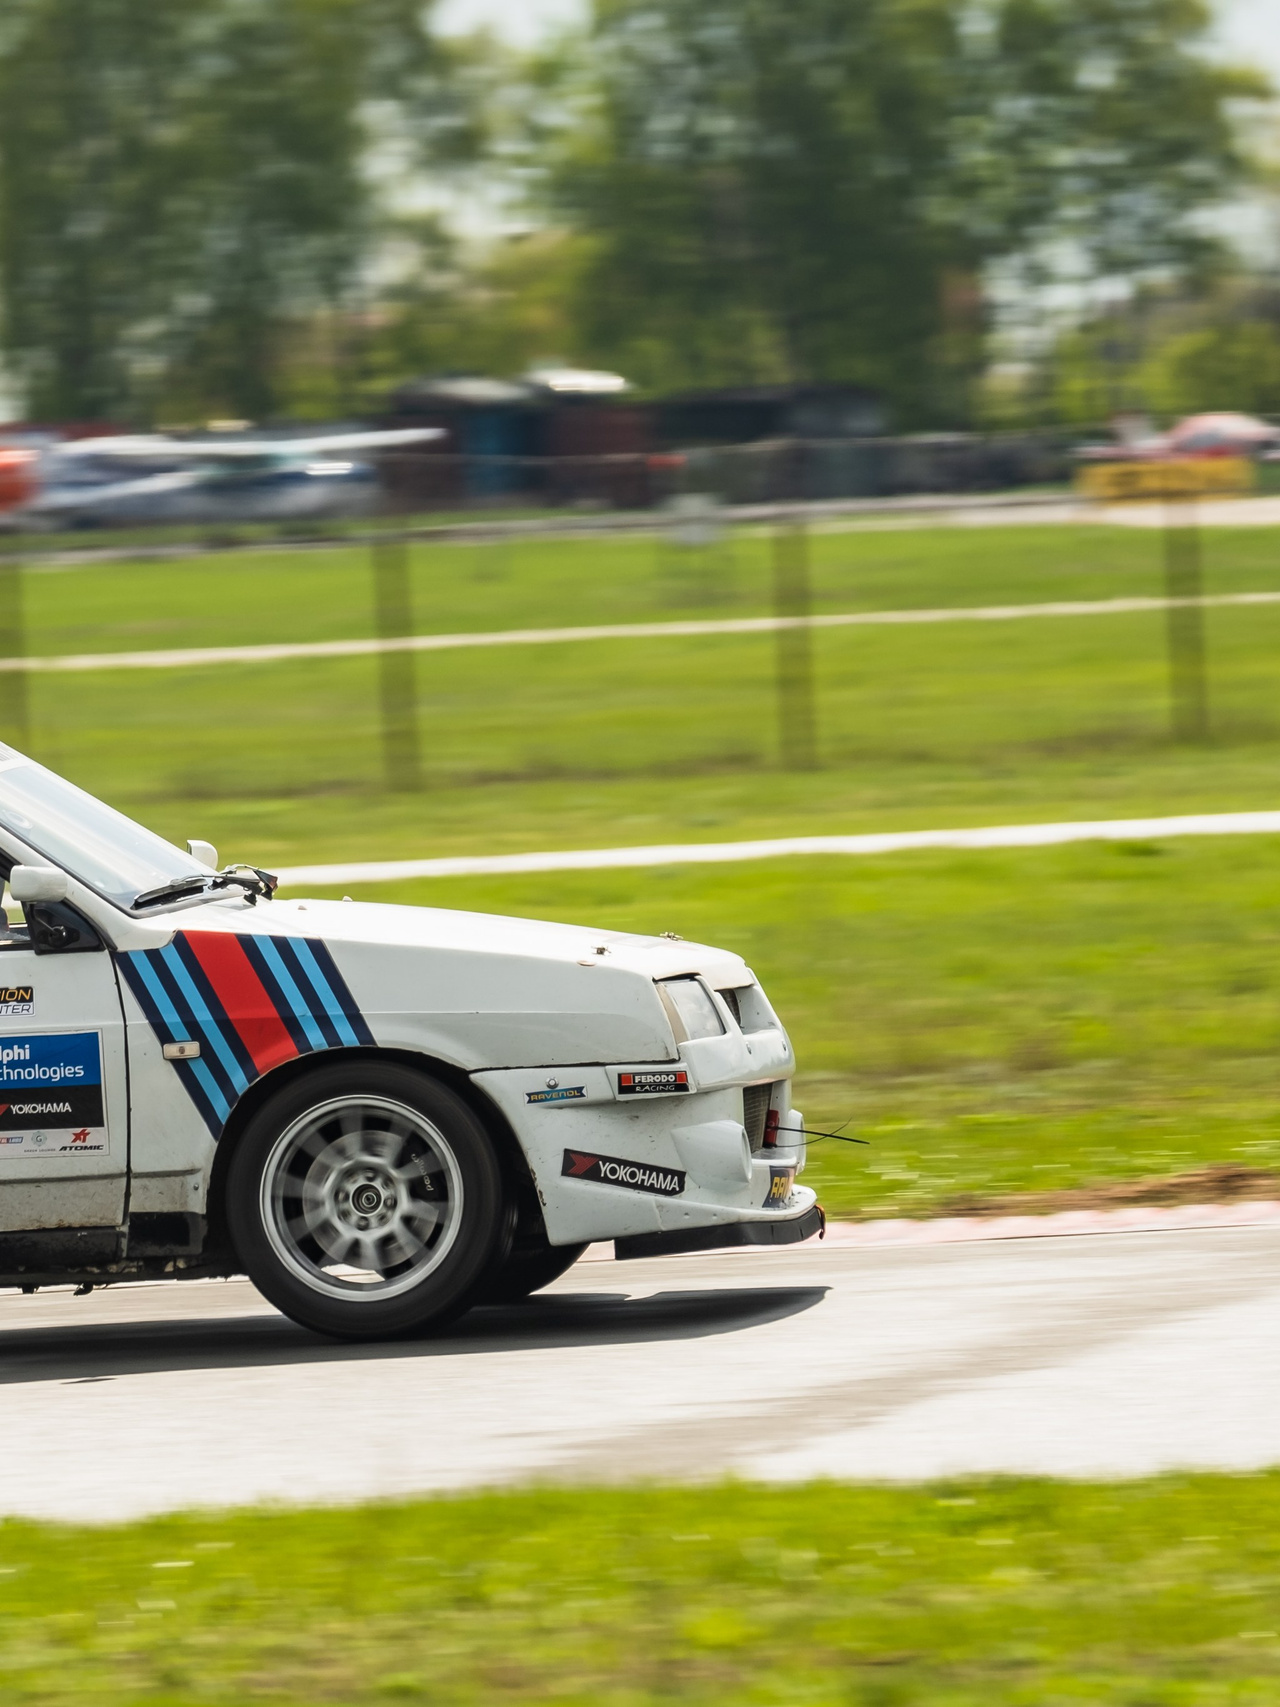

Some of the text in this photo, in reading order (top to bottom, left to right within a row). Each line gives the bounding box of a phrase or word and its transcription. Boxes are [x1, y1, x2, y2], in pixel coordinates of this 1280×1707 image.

[634, 1074, 675, 1083] FERODO
[635, 1084, 676, 1093] RACING
[530, 1089, 581, 1102] RAVENOL
[10, 1102, 72, 1115] YOKOHAMA
[597, 1160, 680, 1192] YOKOHAMA
